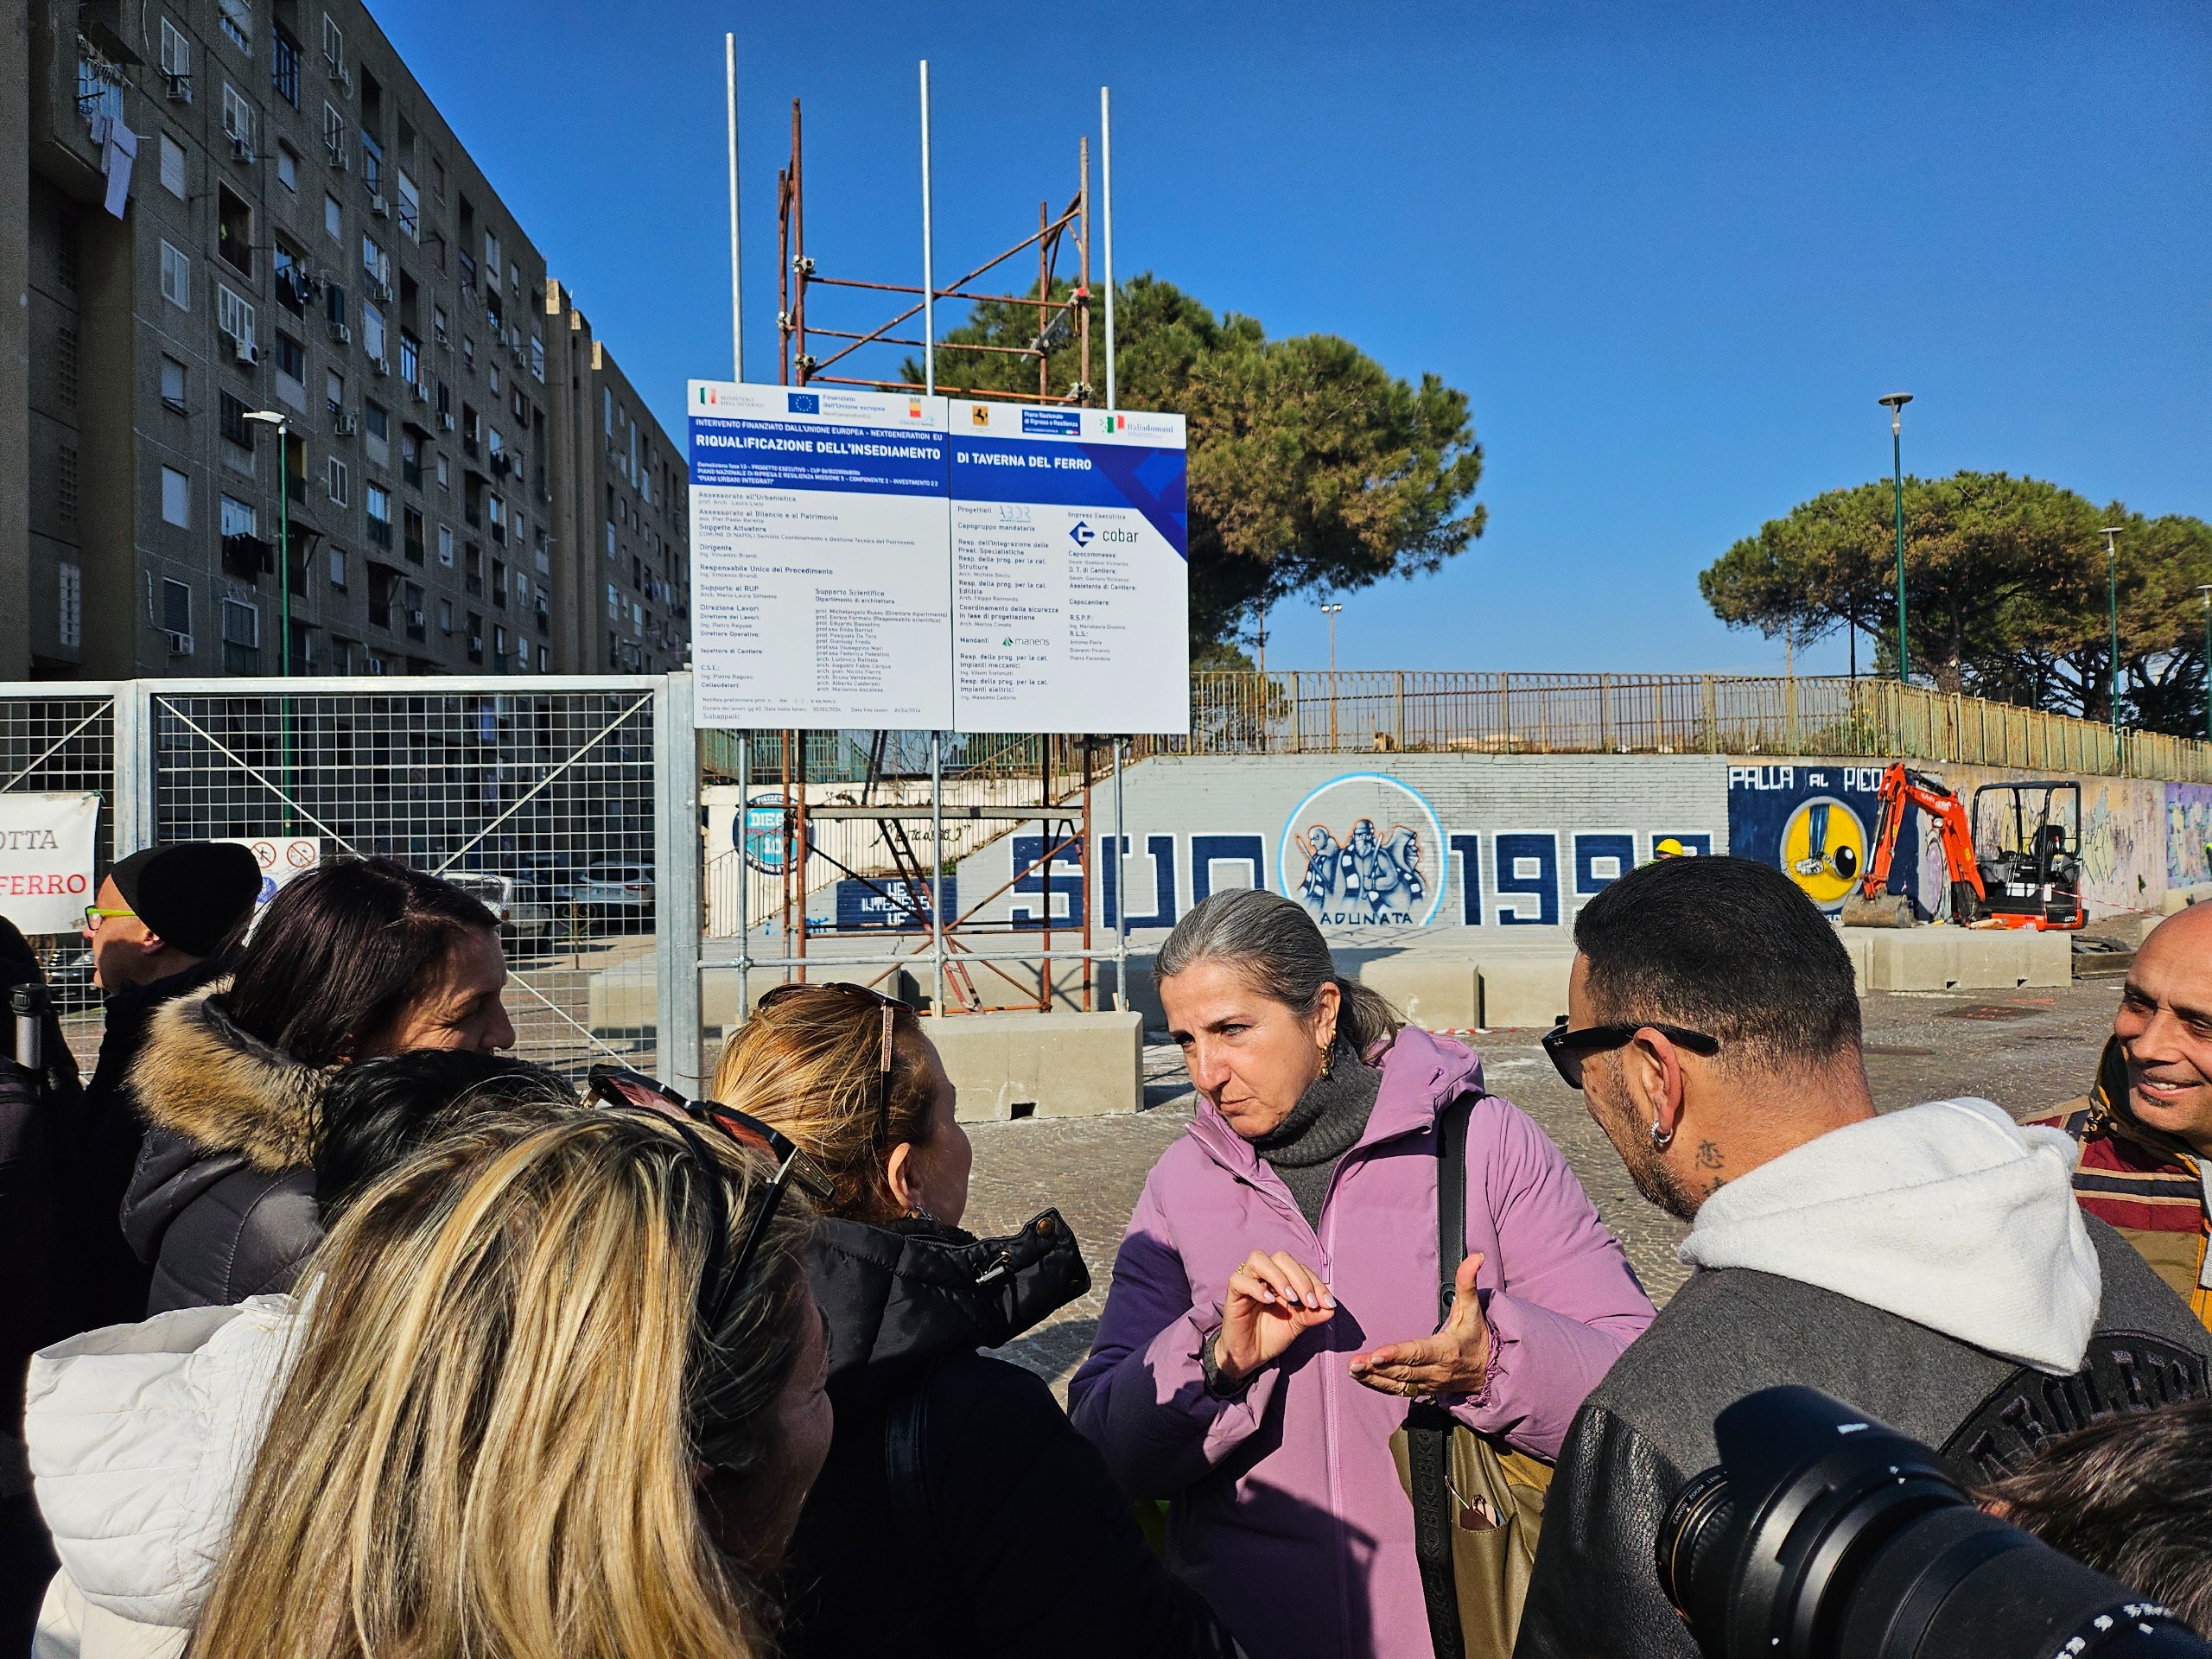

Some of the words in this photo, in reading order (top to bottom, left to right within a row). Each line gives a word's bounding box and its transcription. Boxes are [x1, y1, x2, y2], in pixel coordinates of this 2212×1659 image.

[696, 419, 741, 429] INTERVENTO
[741, 421, 784, 430] FINANZIATO
[785, 423, 830, 434] DALL'UNIONE
[831, 427, 864, 435] EUROPEA
[870, 429, 931, 440] NEXTGENERATION
[696, 435, 813, 452] RIQUALIFICAZIONE
[817, 442, 941, 459] DELL'INSEDIAMENTO
[957, 452, 969, 463] DI
[971, 453, 1026, 467] TAVERNA
[1028, 455, 1052, 468] DEL
[1054, 457, 1092, 470] FERRO
[957, 522, 997, 531] Capogruppo
[1103, 528, 1139, 543] cobar
[700, 543, 732, 552] Dirigente
[815, 588, 847, 597] Supporto
[1014, 638, 1050, 646] manens
[1729, 766, 1785, 790] PALLA
[1809, 773, 1829, 787] AL
[1447, 830, 1715, 926] 199
[1319, 912, 1413, 925] ADUNATA
[1673, 1501, 1688, 1524] CANON
